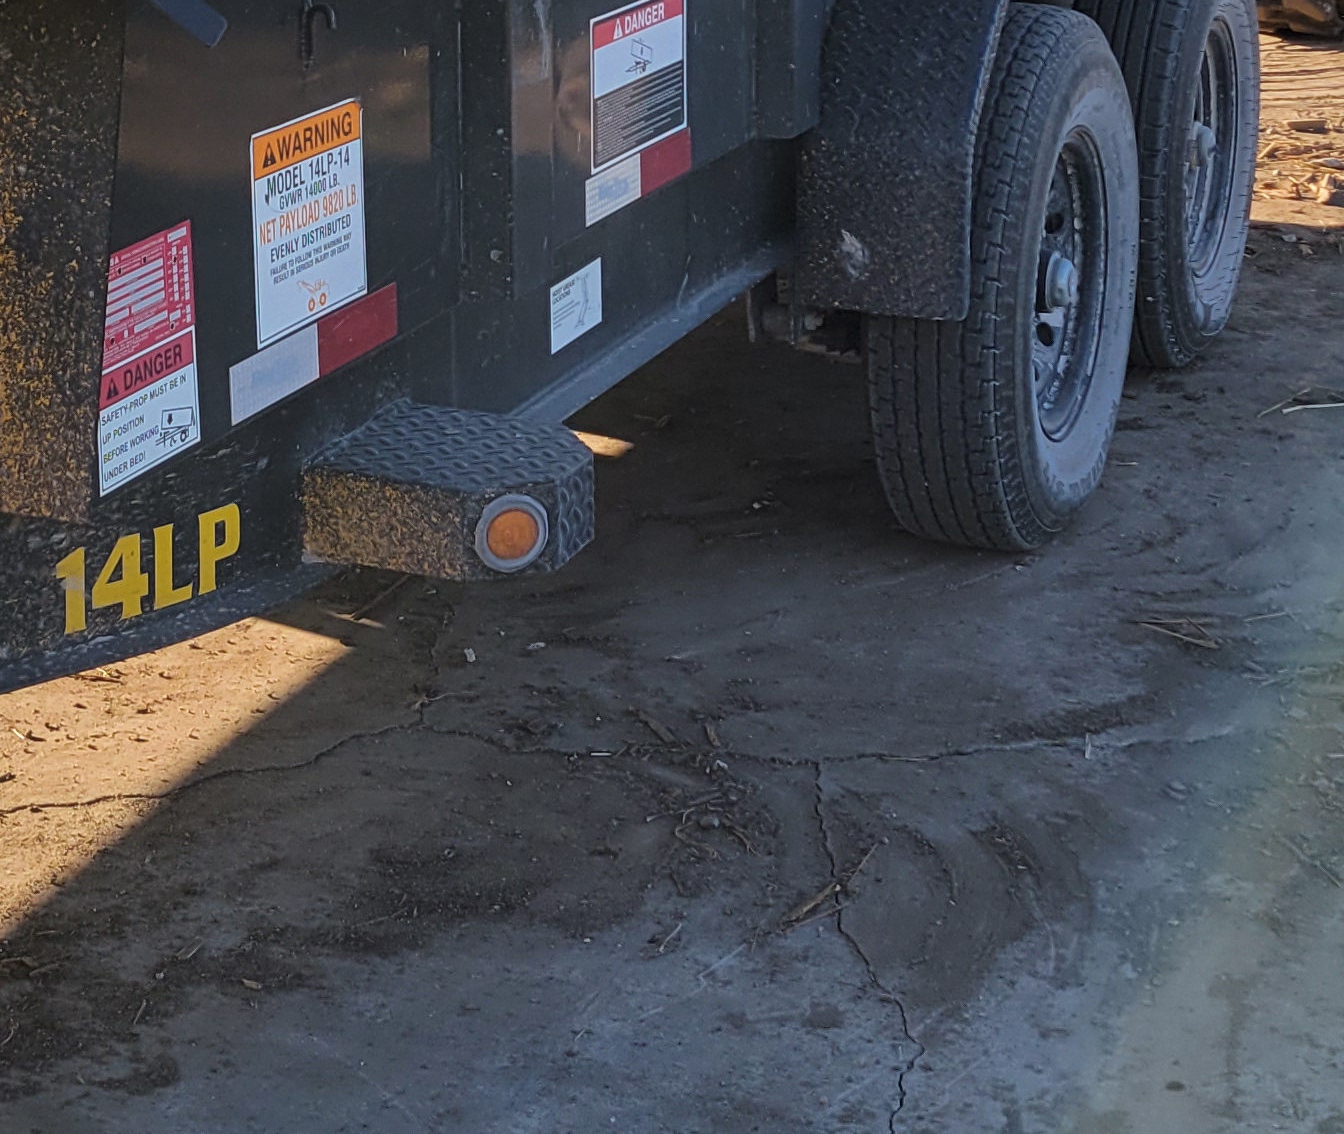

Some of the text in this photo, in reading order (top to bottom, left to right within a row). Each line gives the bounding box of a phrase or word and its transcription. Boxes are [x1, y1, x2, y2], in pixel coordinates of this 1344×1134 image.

[625, 2, 665, 34] DANGER
[277, 112, 352, 162] WARNING
[266, 146, 350, 200] MODEL 14LP-14
[279, 188, 302, 210] GVWR
[305, 178, 326, 199] 14000
[260, 218, 276, 246] NET
[280, 200, 320, 238] PAYLOAD
[323, 189, 343, 217] 9820
[271, 214, 351, 263] EVENLY DISTRIBUTED
[124, 343, 183, 391] DANGER
[150, 384, 168, 401] MUST
[169, 378, 178, 390] BE
[180, 374, 186, 386] IN
[102, 415, 144, 444] UP POSITION
[104, 425, 159, 465] BEFORE WORKING
[104, 462, 128, 483] UNDER
[56, 503, 240, 635] 14LP
